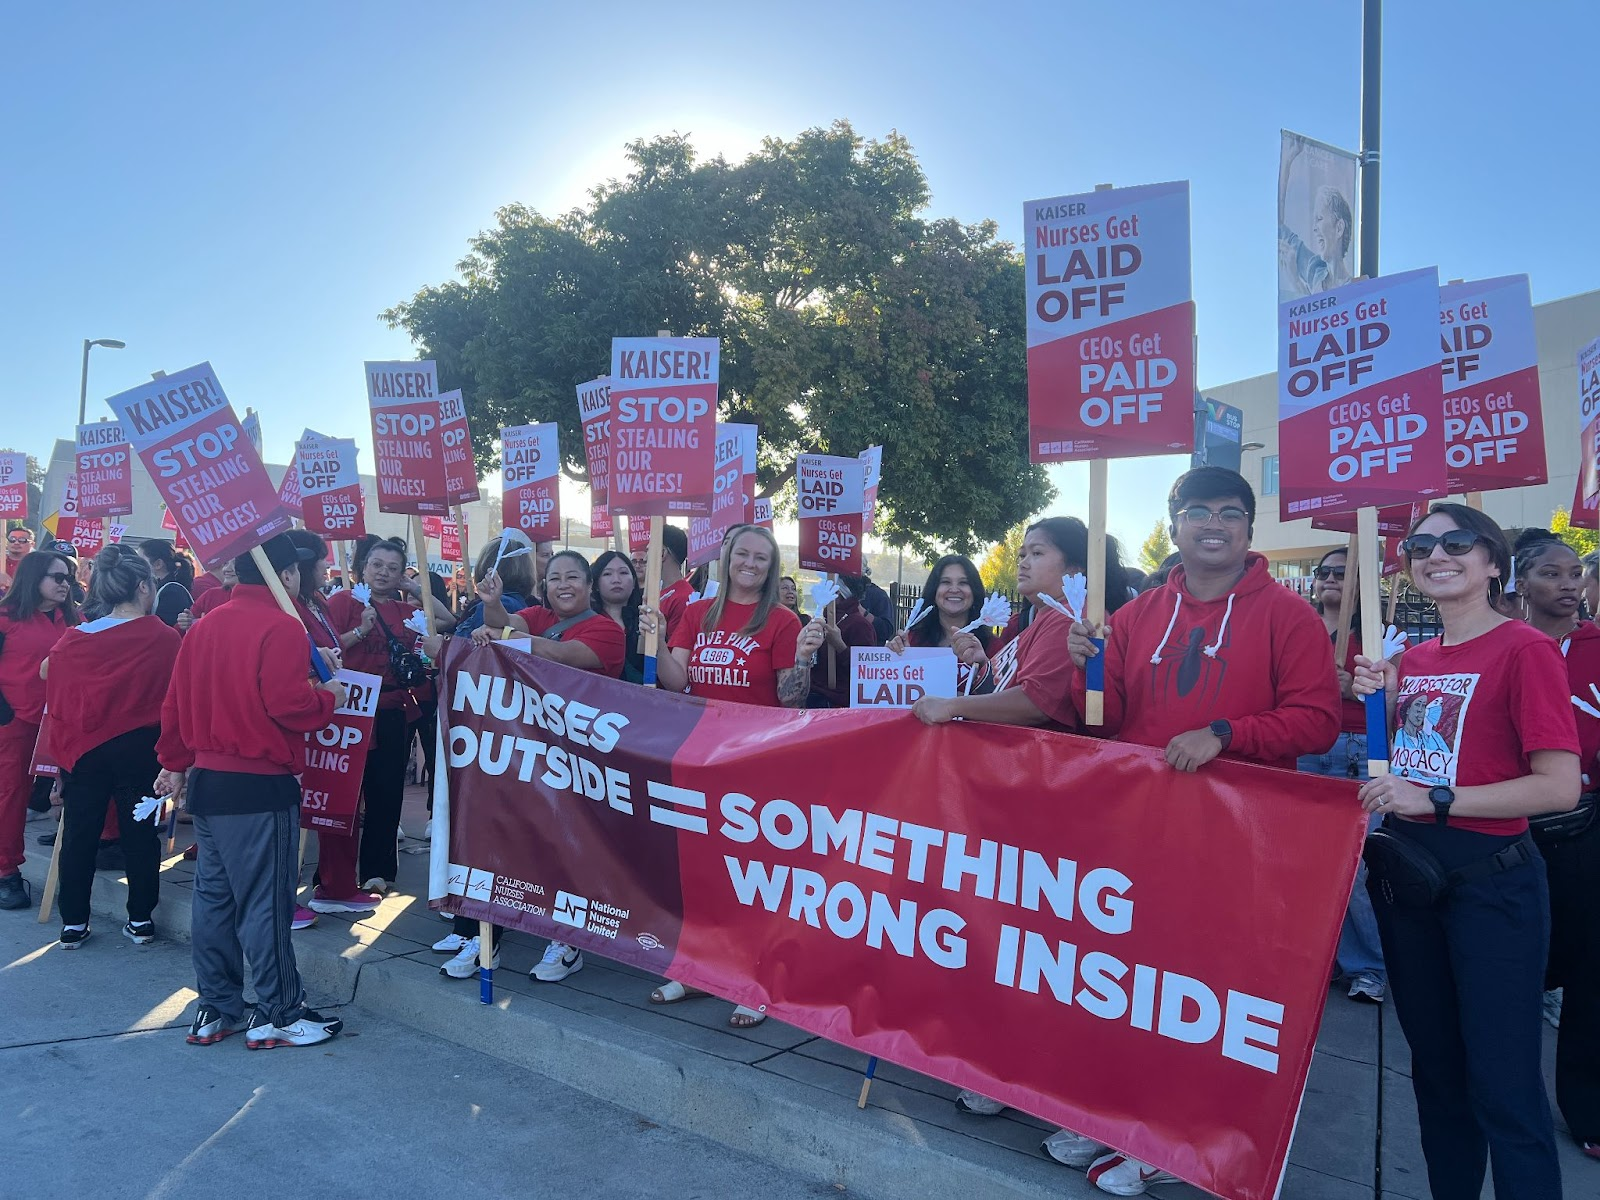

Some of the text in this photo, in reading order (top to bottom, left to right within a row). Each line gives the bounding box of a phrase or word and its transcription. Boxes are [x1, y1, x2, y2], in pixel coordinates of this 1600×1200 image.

[1035, 202, 1086, 221] KAISER
[1036, 214, 1138, 248] Nurses Get
[1036, 244, 1142, 286] LAID
[1036, 283, 1126, 322] OFF
[1290, 296, 1336, 318] KAISER
[1460, 301, 1488, 322] Get
[1289, 298, 1387, 338] Nurses Get
[1080, 333, 1162, 360] CEOs Get
[1288, 322, 1390, 368] LAID
[620, 351, 710, 380] KAISER!
[1442, 354, 1480, 381] FF
[372, 372, 433, 398] KAISER!
[1080, 358, 1178, 394] PAID
[1288, 354, 1374, 398] OFF
[1582, 370, 1600, 396] LA
[125, 377, 222, 436] KAISER!
[440, 398, 462, 420] SER!
[582, 386, 610, 412] KAISE
[1329, 392, 1410, 426] CEOs Get
[1443, 391, 1514, 416] CEOs Get
[1582, 388, 1600, 416] OF
[618, 397, 709, 423] STOP
[1080, 392, 1163, 427] OFF
[1226, 412, 1238, 422] BUS
[376, 413, 436, 436] STOP
[586, 420, 610, 442] STO
[1226, 420, 1240, 428] STOP
[1329, 414, 1428, 454] PAID
[1444, 410, 1528, 442] PAID
[80, 427, 126, 446] KAISER!
[443, 428, 466, 448] OP
[504, 436, 540, 450] Nurses Get
[616, 428, 699, 449] STEALING
[153, 424, 239, 477] STOP
[300, 450, 338, 460] Nurses Get
[376, 440, 432, 458] STEALING
[444, 448, 466, 464] LING
[504, 449, 541, 466] LAID
[1446, 438, 1517, 468] OFF
[80, 452, 126, 470] STOP
[301, 460, 340, 474] LAID
[379, 459, 402, 476] OUR
[591, 460, 607, 476] OUR
[616, 450, 652, 470] OUR
[1328, 444, 1412, 482] OFF
[80, 469, 122, 483] STEALING
[168, 454, 250, 504] STEALING
[302, 475, 336, 488] OFF
[504, 466, 536, 482] OFF
[616, 473, 683, 494] WAGES!
[714, 469, 738, 494] OP
[802, 467, 842, 480] Nurses Get
[81, 484, 100, 495] OUR
[285, 482, 300, 494] OU
[381, 479, 426, 496] WAGES!
[447, 477, 464, 492] GES!
[520, 488, 549, 499] CEOs Get
[802, 480, 844, 496] LAID
[82, 493, 116, 508] WAGES!
[182, 493, 224, 524] OUR
[281, 491, 302, 507] WAG
[322, 494, 338, 504] CEOs
[338, 494, 350, 503] Get
[520, 498, 554, 514] PAID
[712, 492, 734, 513] LING
[802, 496, 836, 512] OFF
[322, 504, 358, 516] PAID
[191, 500, 261, 546] WAGES!
[324, 516, 354, 529] OFF
[443, 526, 459, 536] STO
[520, 514, 550, 528] OFF
[630, 522, 645, 532] OUR
[692, 517, 710, 536] OUR
[818, 520, 850, 532] CEOs Get
[74, 526, 102, 538] PAID
[818, 530, 857, 547] PAID
[71, 538, 98, 548] OFF
[818, 548, 852, 560] OFF
[858, 652, 891, 662] KAISER
[688, 666, 750, 688] FOOTBALL
[858, 664, 924, 681] Nurses Get
[858, 684, 926, 705] LAID
[1444, 678, 1472, 694] FOR
[452, 670, 630, 753] NURSES
[314, 722, 363, 750] OP
[306, 748, 350, 774] LING
[302, 788, 328, 811] ES!
[450, 726, 634, 816] OUTSIDE
[720, 792, 1134, 934] SOMETHING
[494, 886, 524, 900] NURSES
[496, 876, 545, 896] CALIFORNIA
[493, 897, 546, 917] ASSOCIATION
[590, 900, 630, 920] National
[589, 911, 620, 928] Nurses
[587, 922, 618, 940] United
[724, 855, 1285, 1074] WRONG INSIDE
